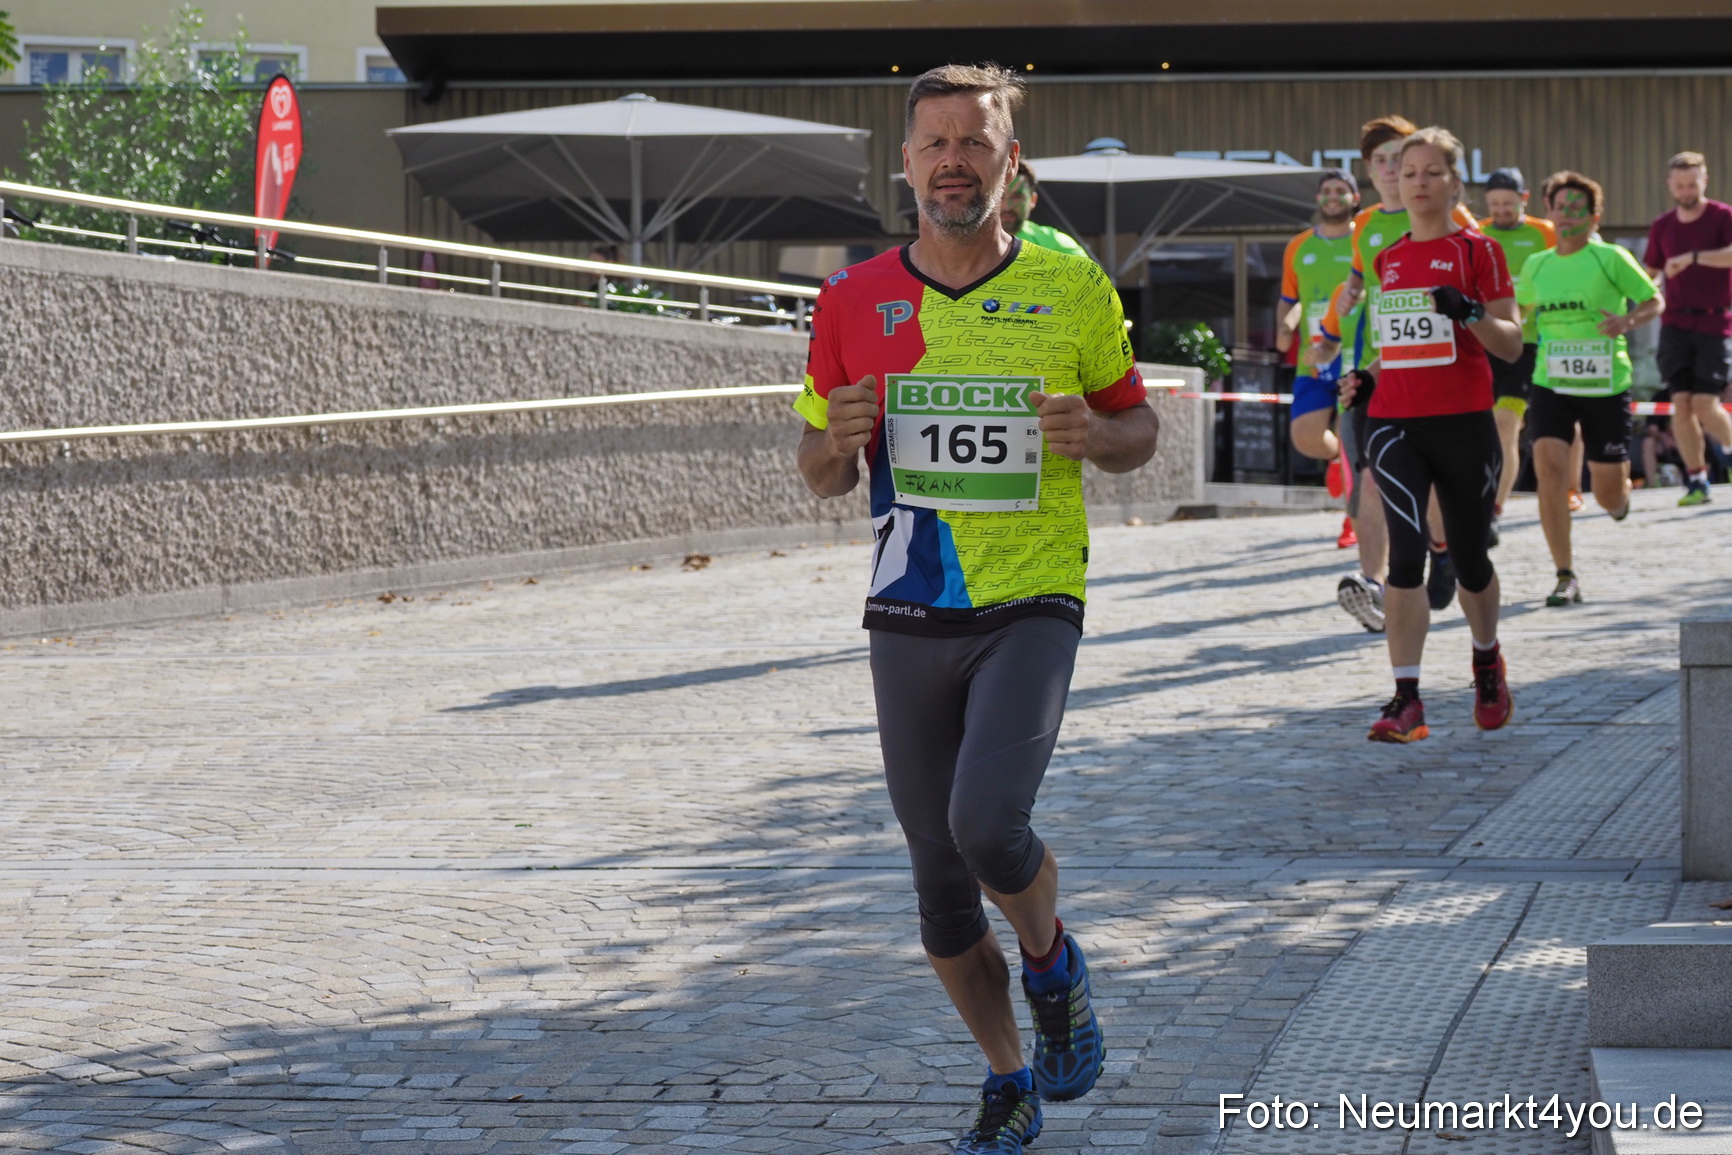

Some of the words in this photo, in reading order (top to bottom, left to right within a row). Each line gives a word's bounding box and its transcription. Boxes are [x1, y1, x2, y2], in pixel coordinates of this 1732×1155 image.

[1430, 259, 1454, 272] Kat
[1390, 317, 1433, 341] 549
[1561, 359, 1597, 375] 184
[899, 383, 1028, 410] BOCK
[1026, 428, 1038, 436] E6
[920, 424, 1008, 465] 165
[905, 474, 965, 493] FRANK
